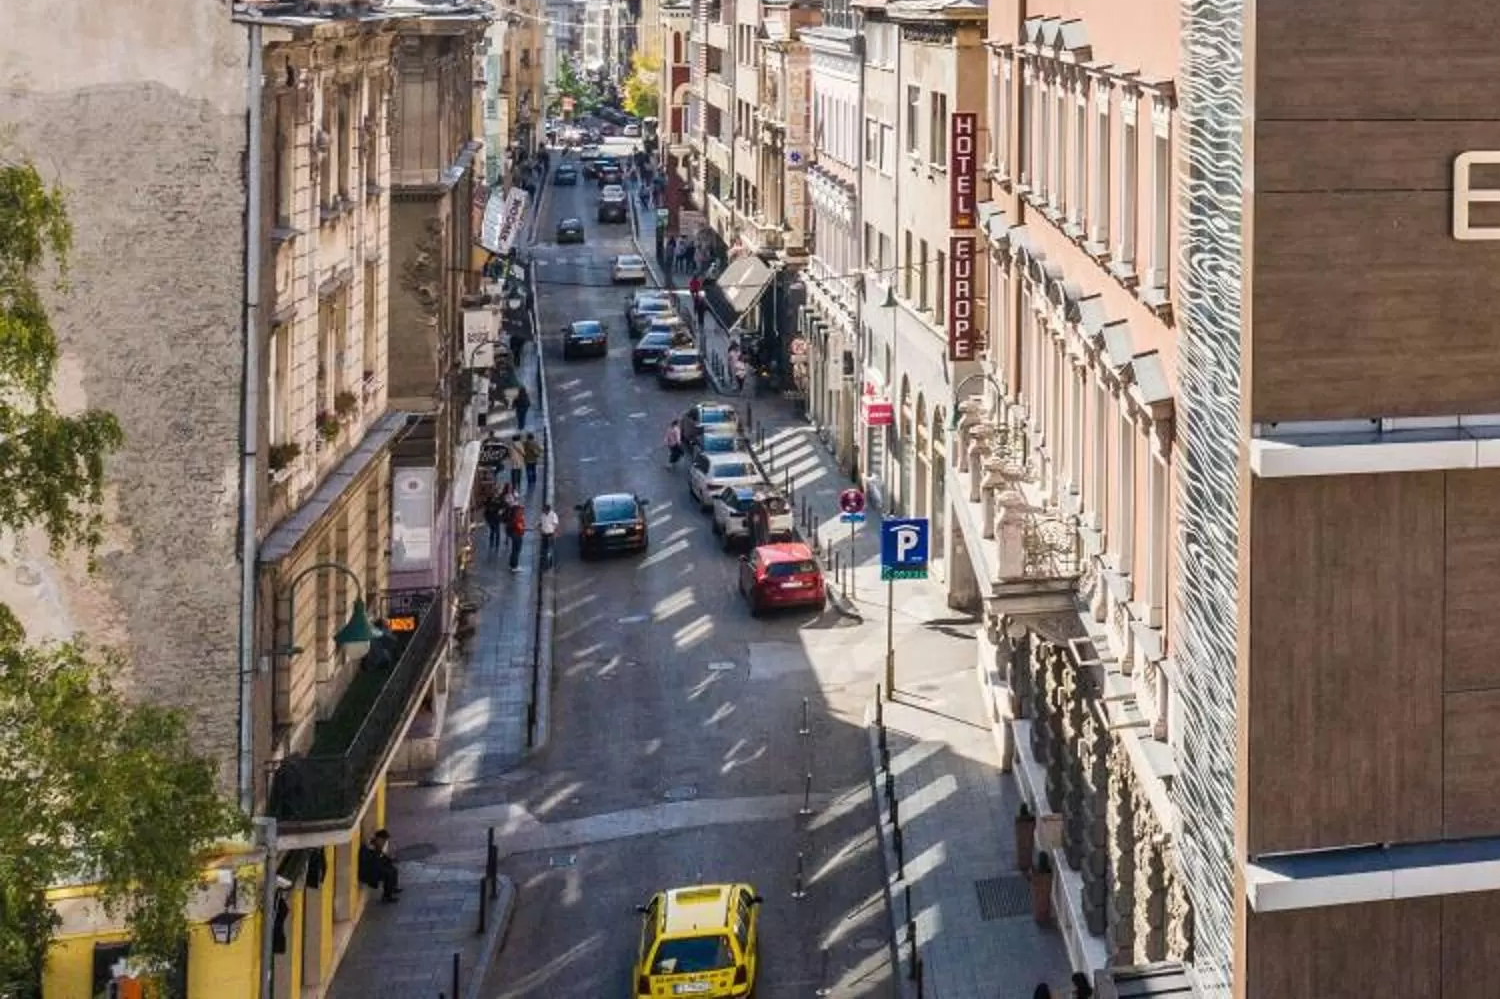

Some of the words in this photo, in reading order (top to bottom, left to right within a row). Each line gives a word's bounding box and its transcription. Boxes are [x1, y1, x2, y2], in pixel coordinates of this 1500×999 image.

[790, 72, 803, 140] HOTEL
[956, 116, 972, 214] HOTEL
[955, 239, 970, 358] EUROPE
[897, 530, 918, 562] P
